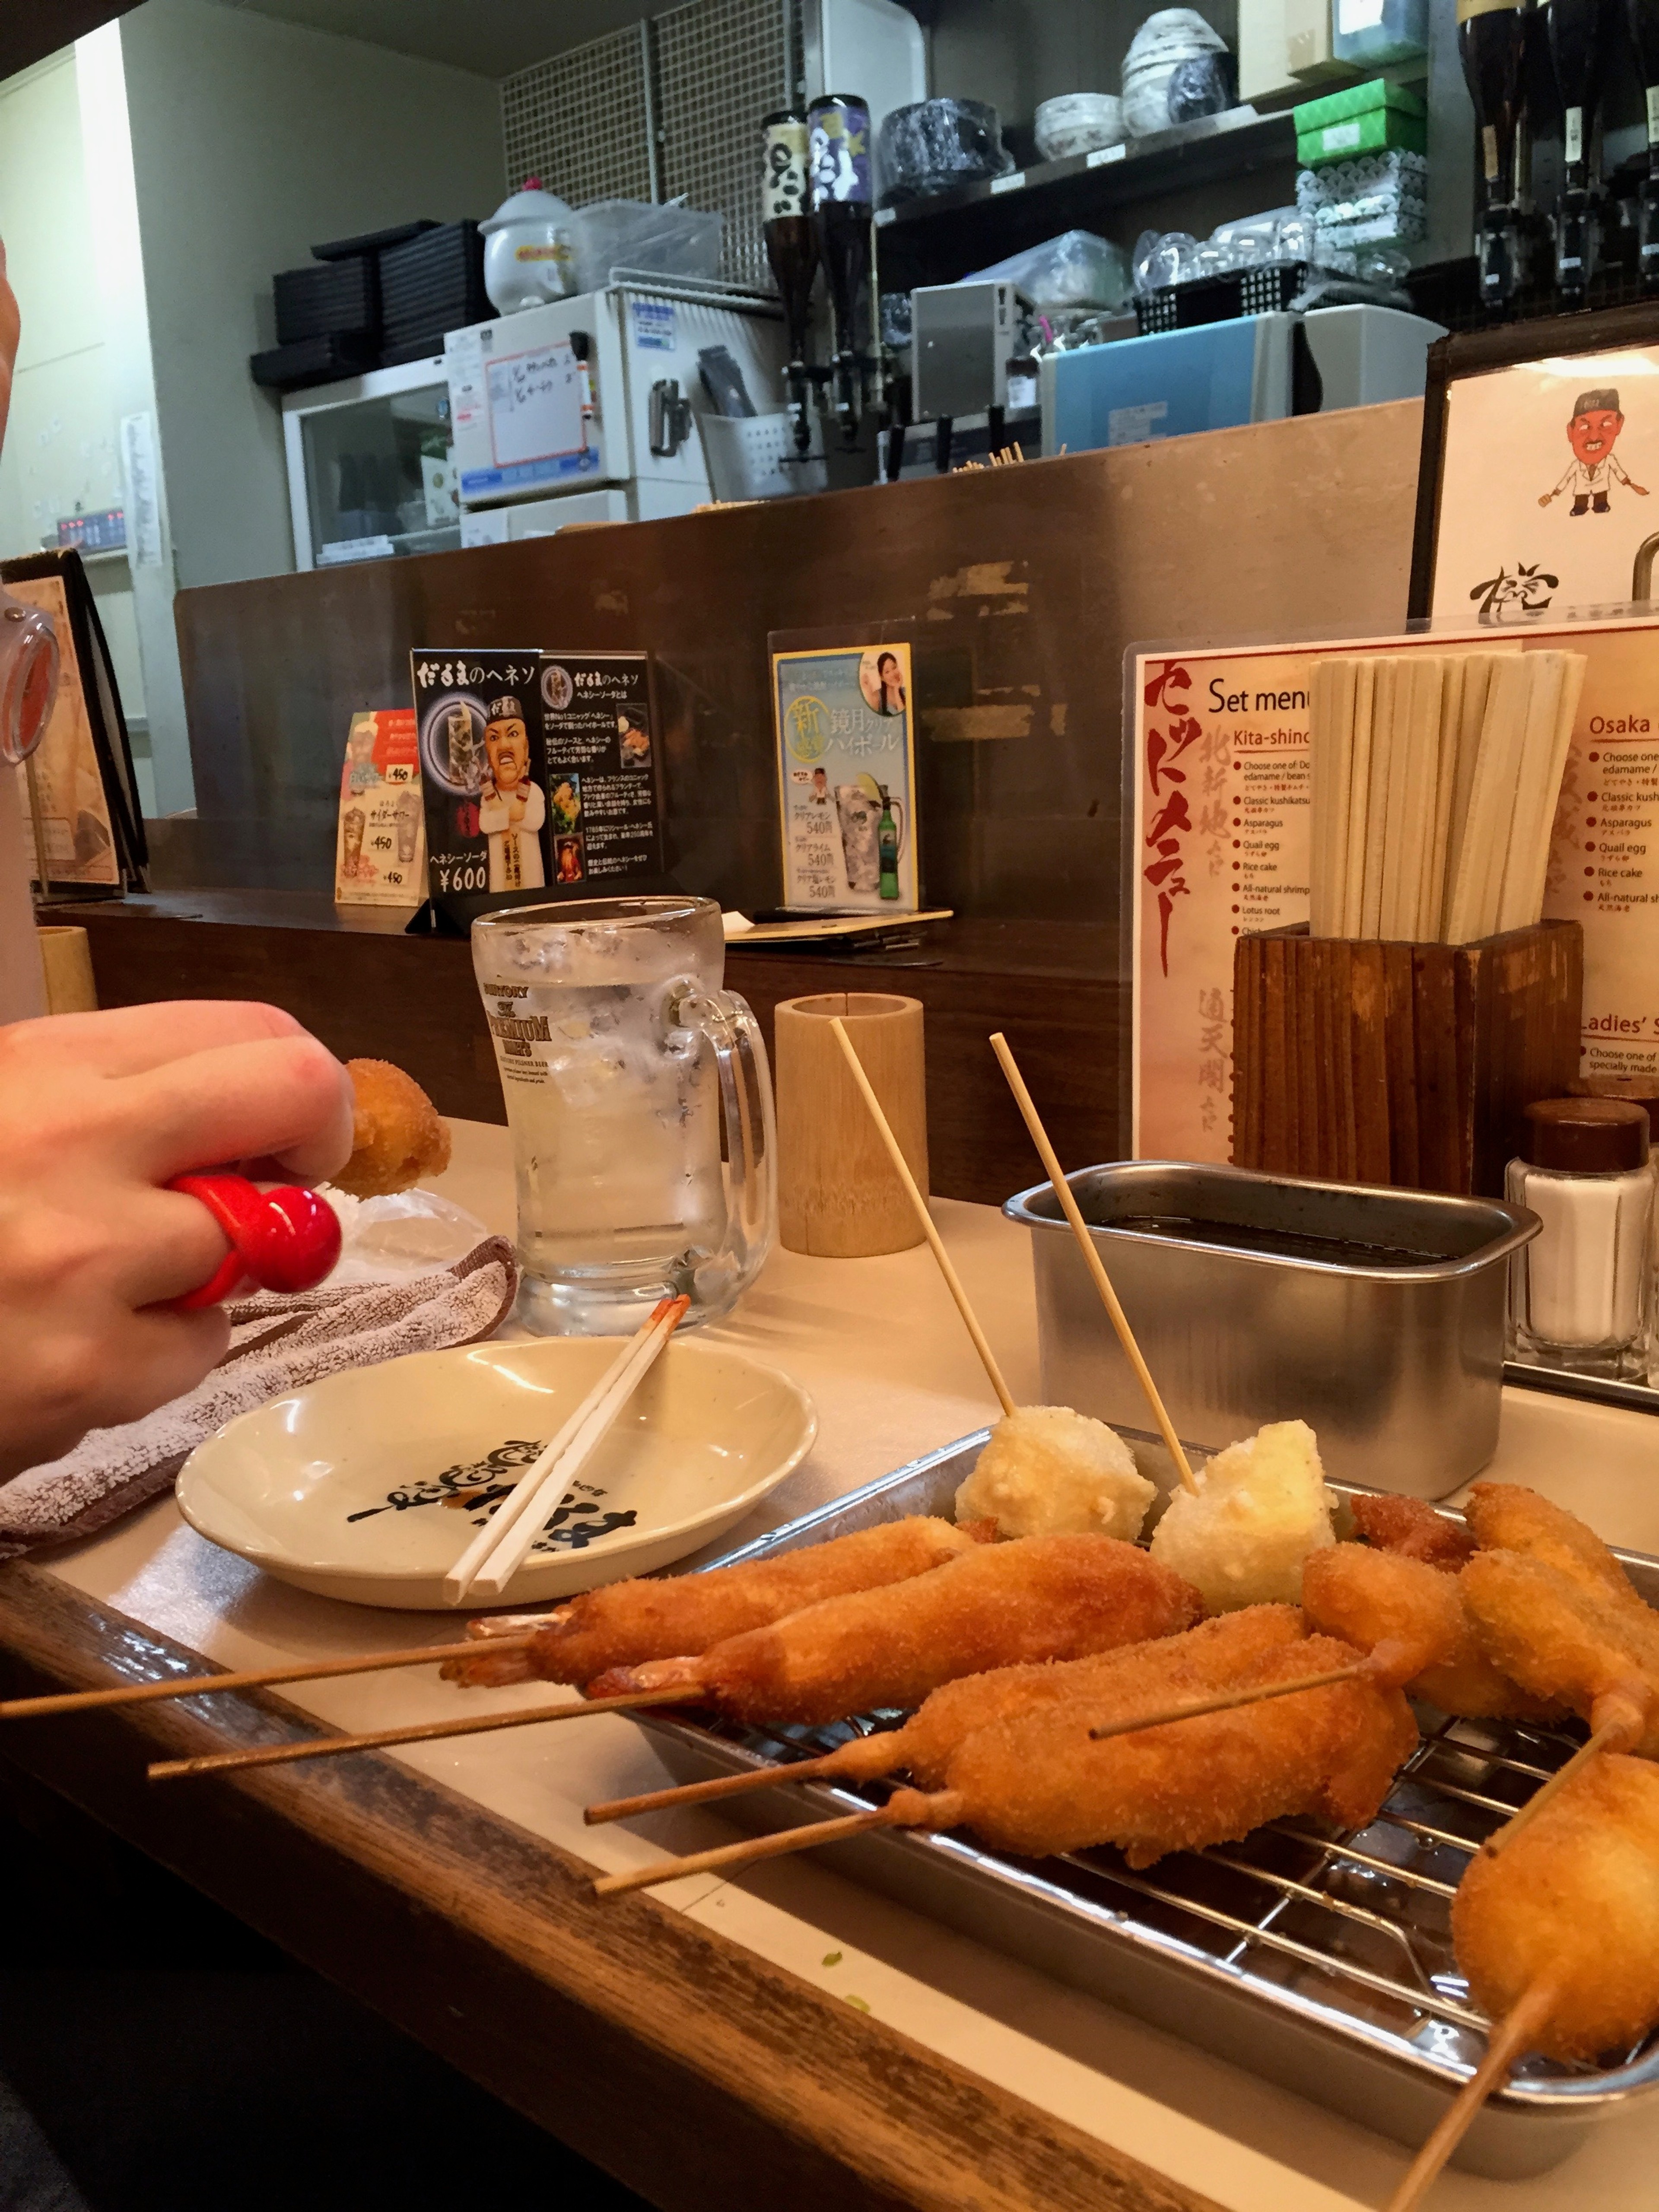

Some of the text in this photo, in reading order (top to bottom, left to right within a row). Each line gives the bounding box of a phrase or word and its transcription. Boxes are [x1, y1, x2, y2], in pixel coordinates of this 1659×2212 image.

[417, 660, 535, 688] だるまのヘネソ
[574, 671, 639, 687] だるまのヘネソ
[1208, 678, 1249, 713] Set
[1589, 714, 1650, 734] Osaka
[1603, 752, 1659, 763] Choose one
[1244, 761, 1271, 770] Choose
[1603, 764, 1650, 774] edamame
[1244, 772, 1280, 781] edamame
[1287, 772, 1306, 781] bean
[1244, 795, 1311, 805] Classic kushikatsu
[1602, 791, 1634, 802] Classic
[1144, 660, 1202, 978] セットメニュー
[1243, 818, 1283, 829] Asparagus
[1601, 818, 1652, 830] Asparagus
[1243, 840, 1280, 851] Quail egg
[1599, 842, 1646, 855] Quail egg
[430, 850, 487, 865] ヘネシーソーダ
[1243, 862, 1278, 871] Rice cake
[1598, 868, 1643, 878] Rice cake
[440, 866, 486, 893] ¥600
[1243, 885, 1310, 896] All-natural shrimp
[1598, 892, 1648, 903] All-natural
[1242, 906, 1280, 915] Lotus root
[1590, 1047, 1624, 1059] Choose
[1589, 1061, 1657, 1074] specially made
